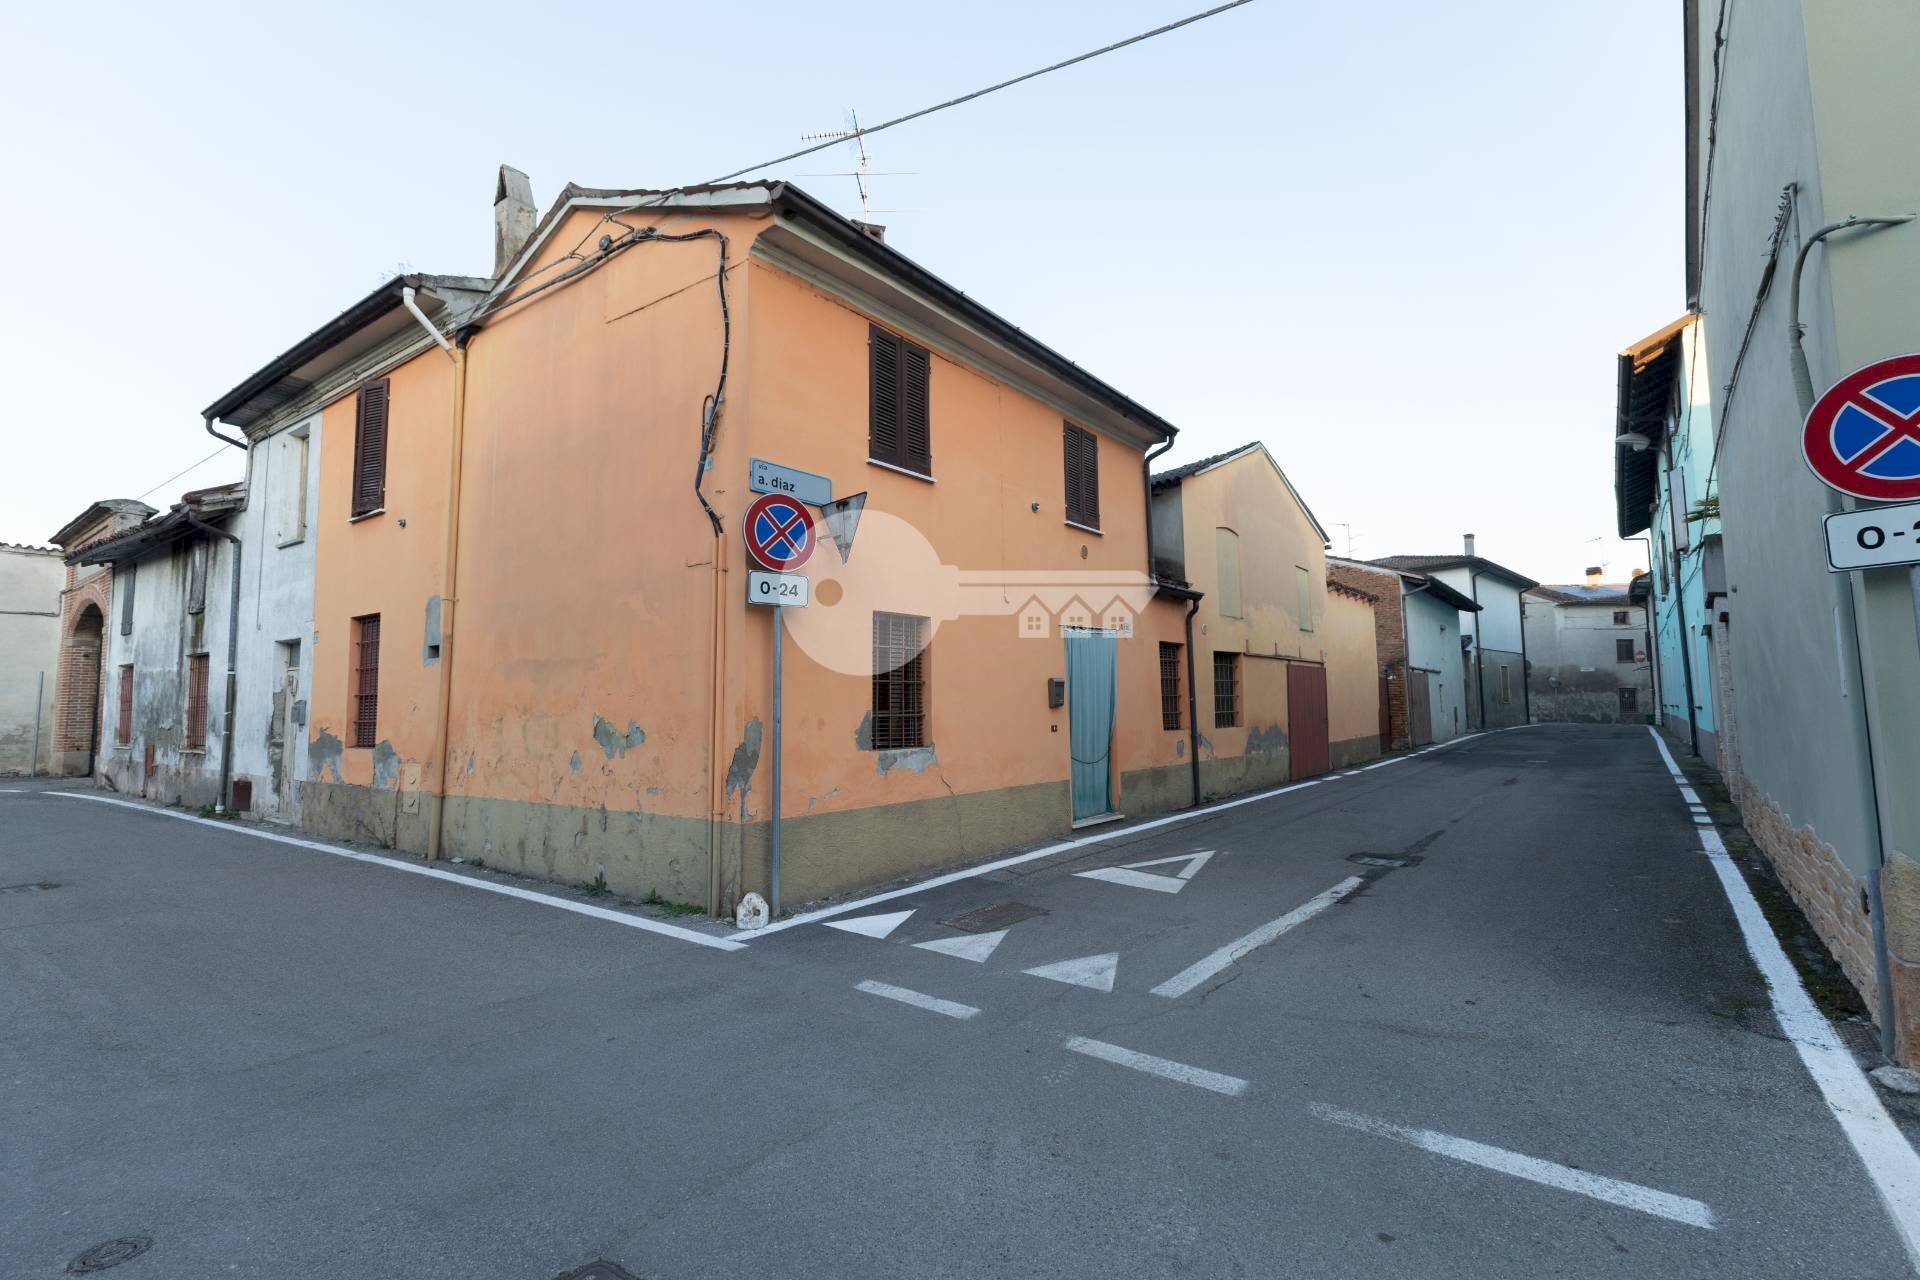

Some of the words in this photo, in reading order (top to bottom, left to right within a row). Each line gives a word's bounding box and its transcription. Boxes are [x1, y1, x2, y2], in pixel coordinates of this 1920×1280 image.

[758, 463, 768, 471] via
[758, 475, 769, 486] a.
[771, 476, 795, 492] diaz
[760, 580, 799, 597] 0-24
